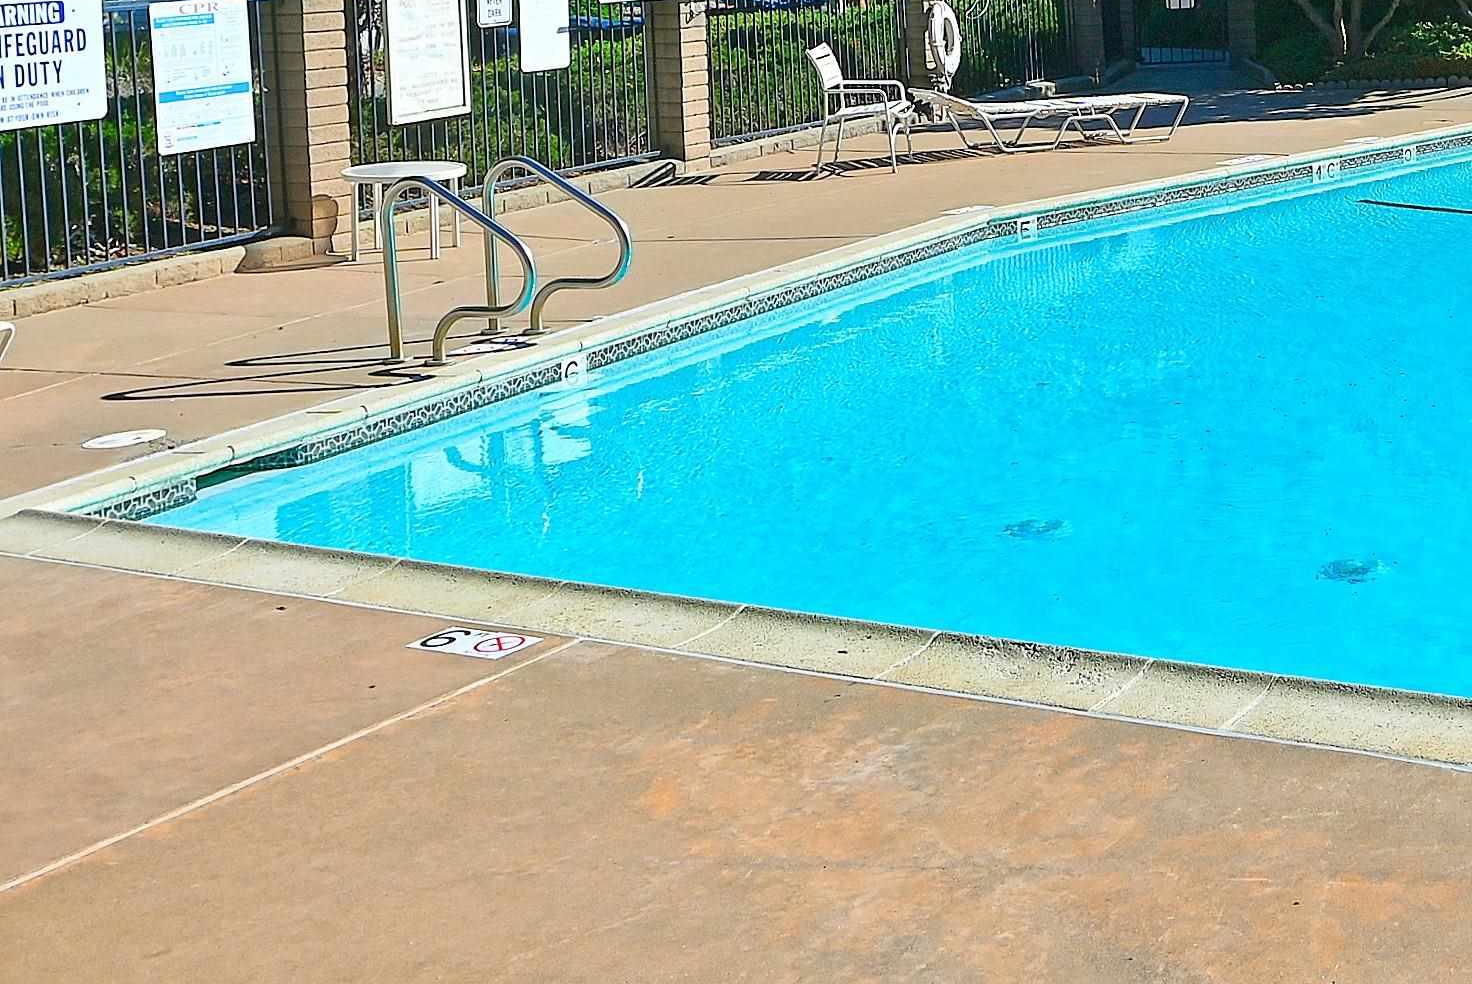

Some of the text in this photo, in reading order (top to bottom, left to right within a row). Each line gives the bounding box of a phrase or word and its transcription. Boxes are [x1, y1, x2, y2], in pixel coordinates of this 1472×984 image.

[179, 2, 220, 14] CPR
[0, 28, 87, 58] FEGUARD
[15, 60, 62, 88] DUTY
[420, 629, 471, 648] 6
